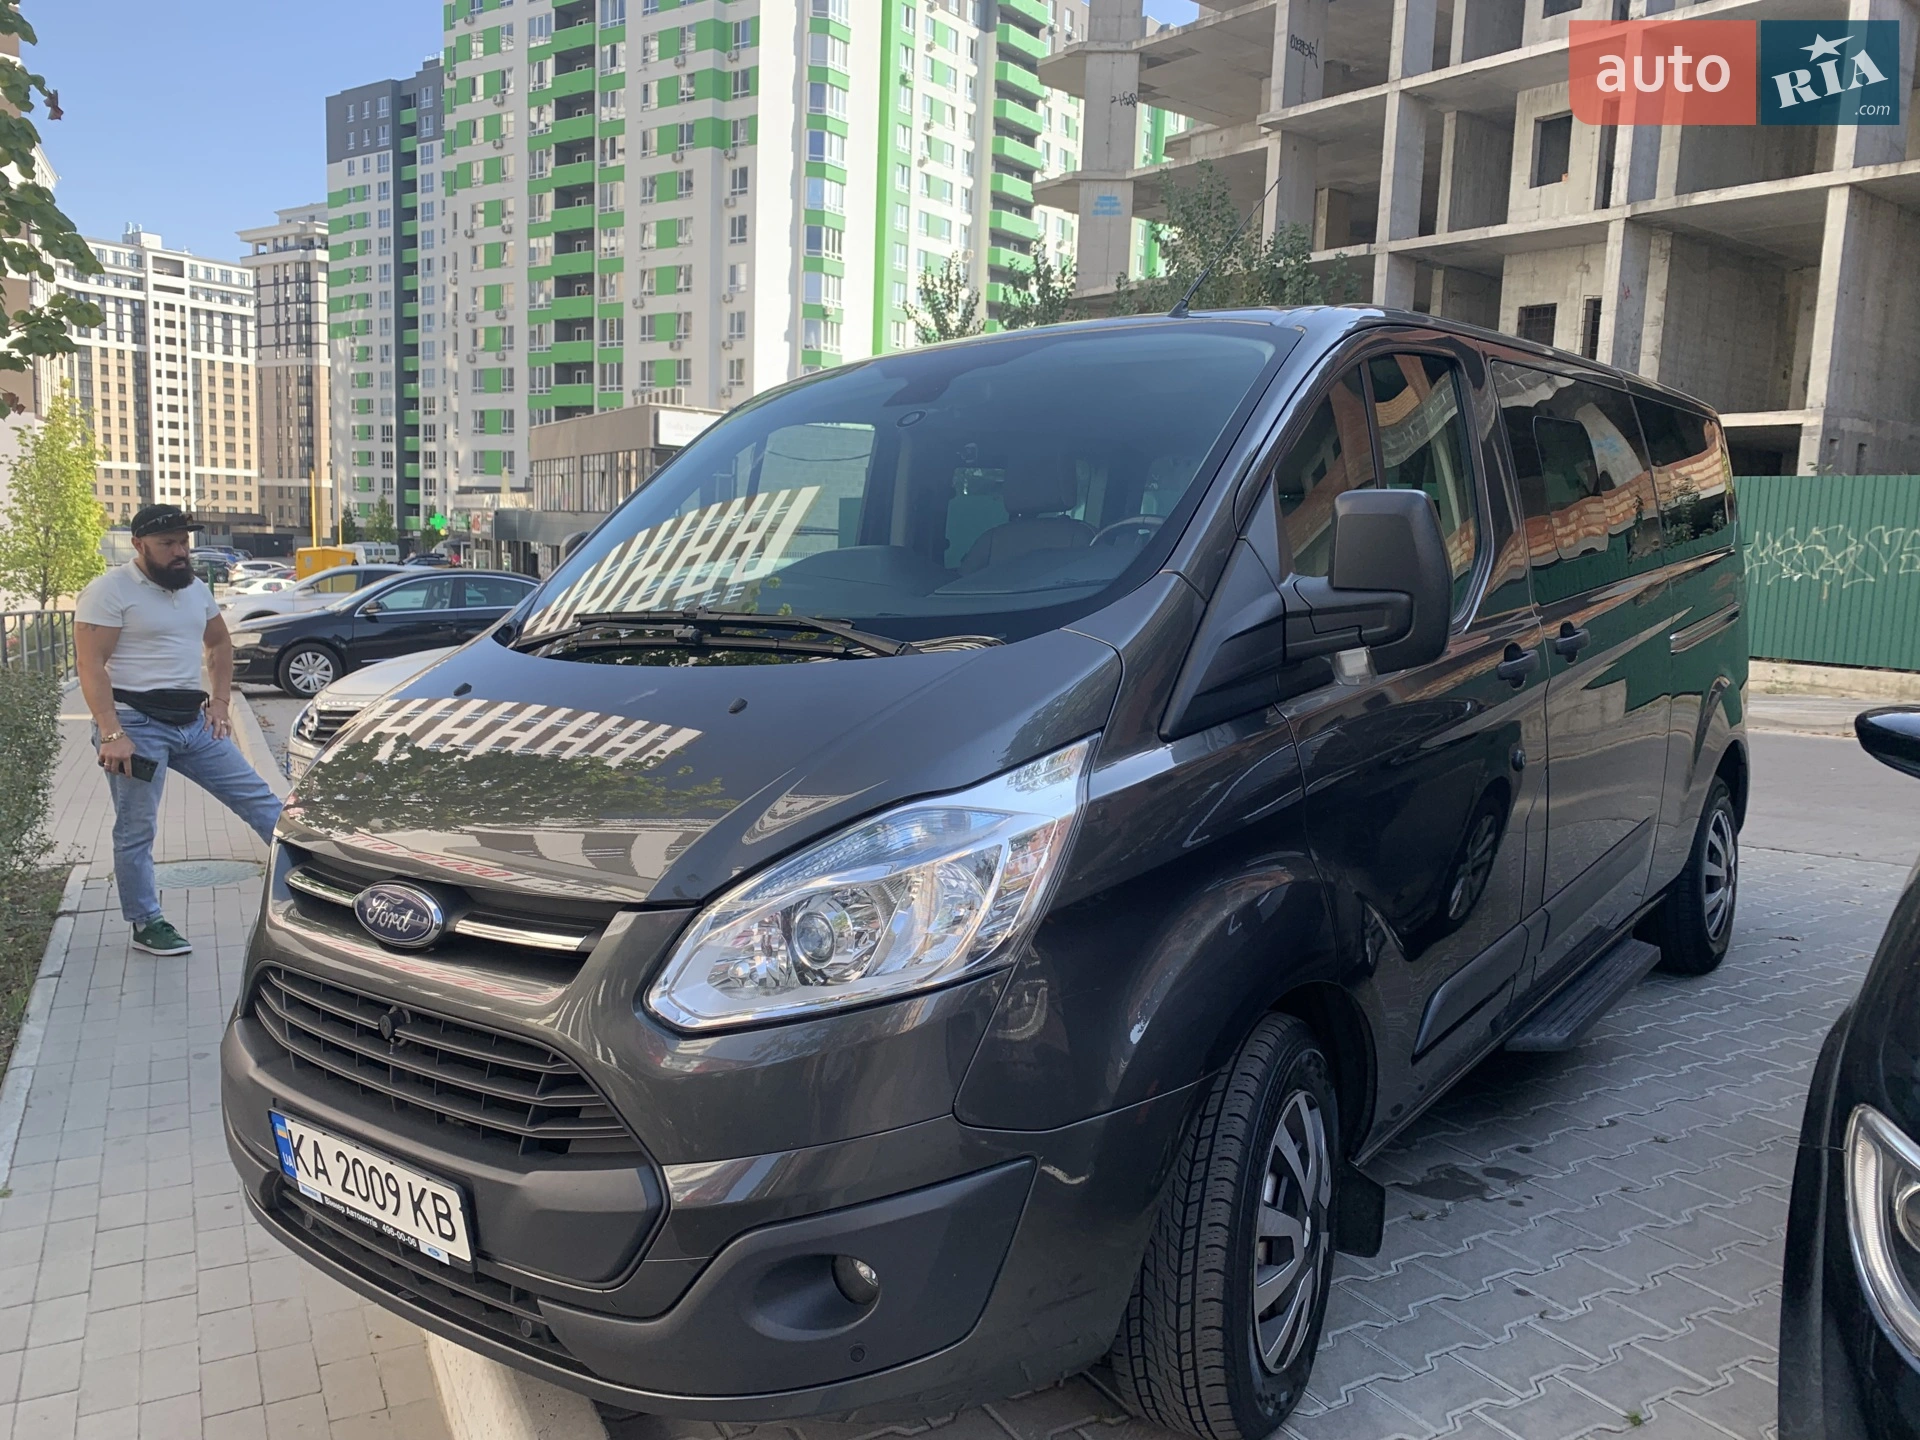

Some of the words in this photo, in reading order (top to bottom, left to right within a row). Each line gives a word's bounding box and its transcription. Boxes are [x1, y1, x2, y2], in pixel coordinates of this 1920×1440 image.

[366, 892, 414, 933] Ford
[281, 1152, 295, 1170] UA
[287, 1129, 333, 1187] KA
[335, 1150, 402, 1217] 2009
[407, 1181, 457, 1242] KB
